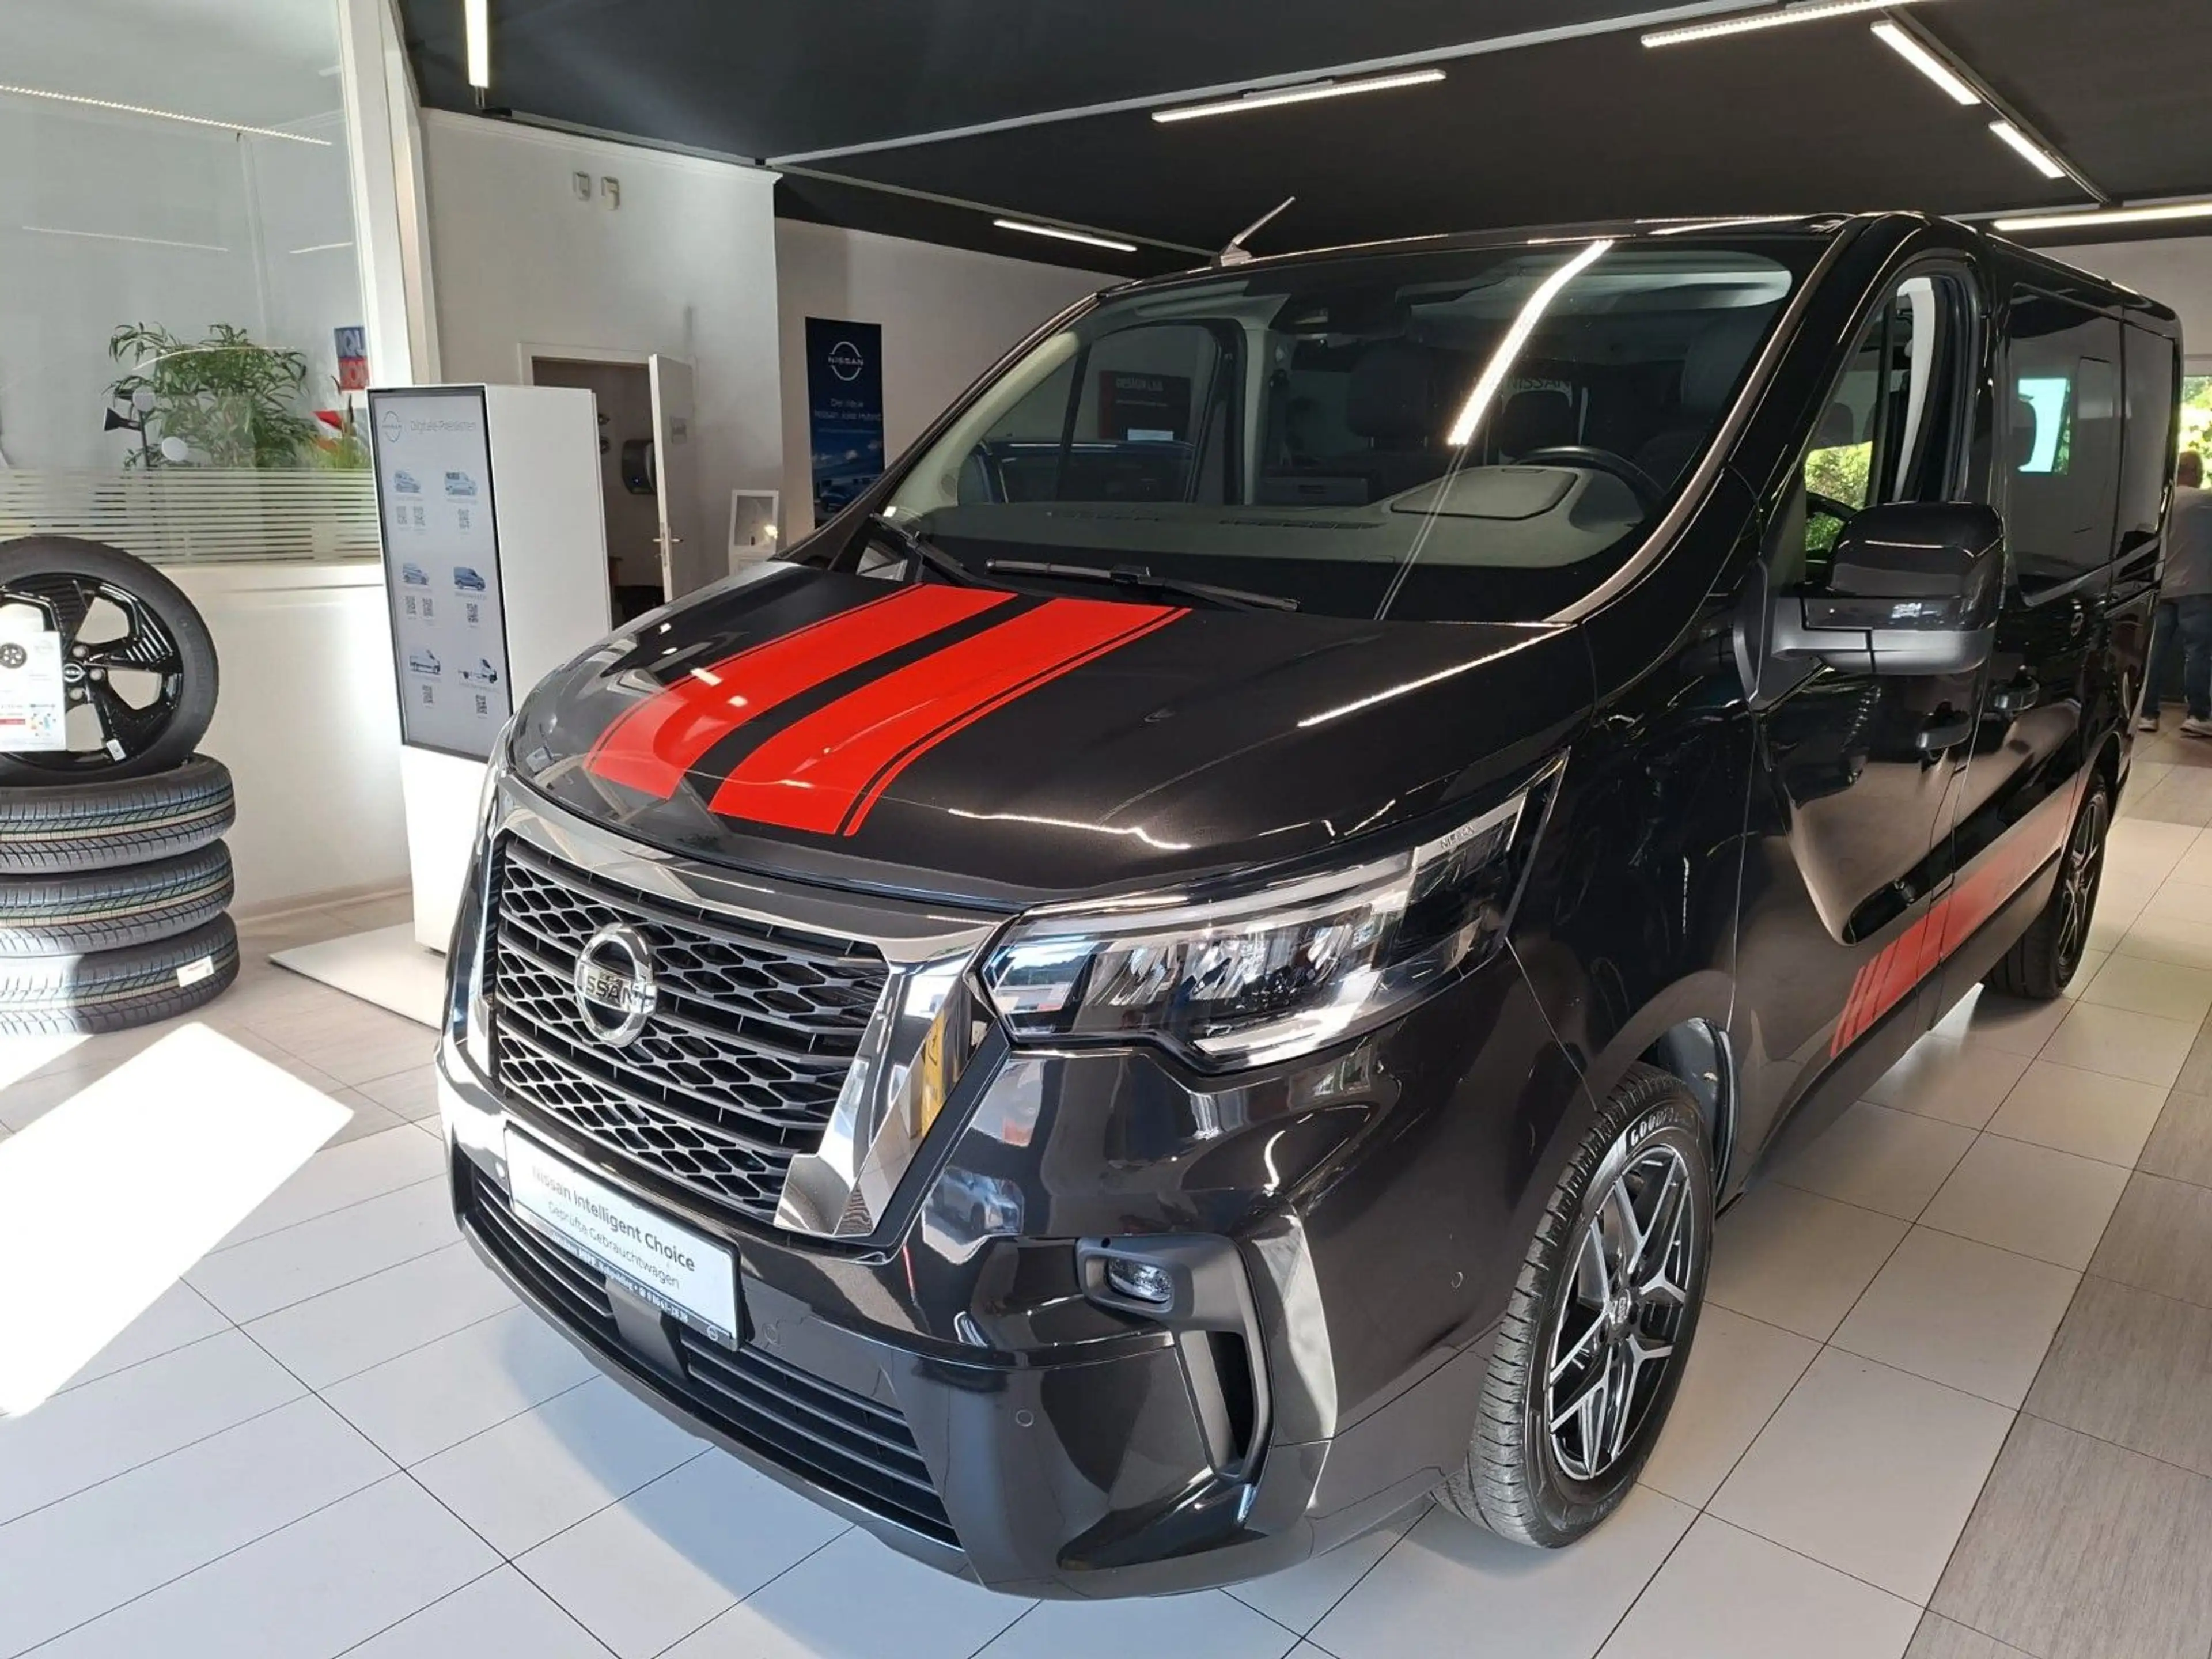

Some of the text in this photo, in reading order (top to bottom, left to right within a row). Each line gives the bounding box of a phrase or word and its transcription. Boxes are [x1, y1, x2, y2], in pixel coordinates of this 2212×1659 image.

[532, 1166, 571, 1200] Nissan
[574, 1190, 642, 1244] Intelligent
[643, 1232, 696, 1272] Choice
